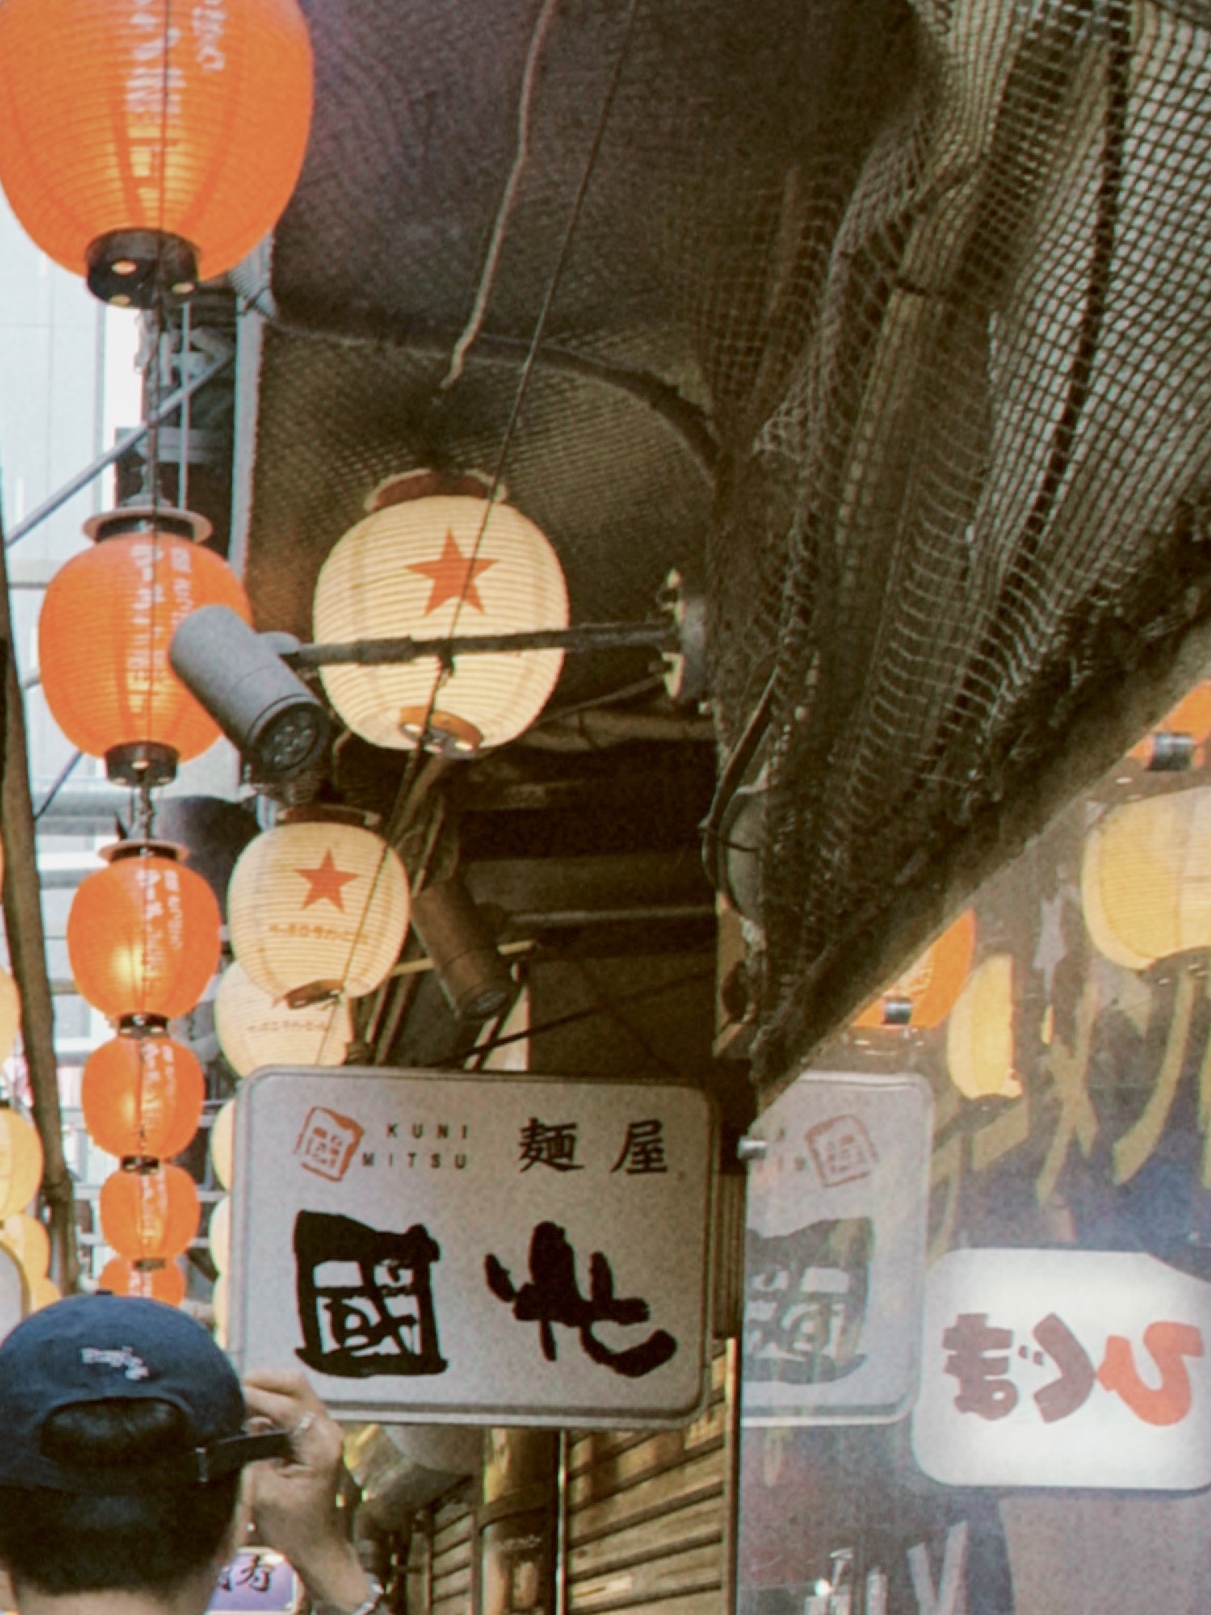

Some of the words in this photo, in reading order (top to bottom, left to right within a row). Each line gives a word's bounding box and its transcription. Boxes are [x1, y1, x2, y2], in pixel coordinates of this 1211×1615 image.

[387, 1124, 467, 1139] KUNI
[518, 1116, 667, 1174] 麺屋
[362, 1153, 466, 1169] MITSU
